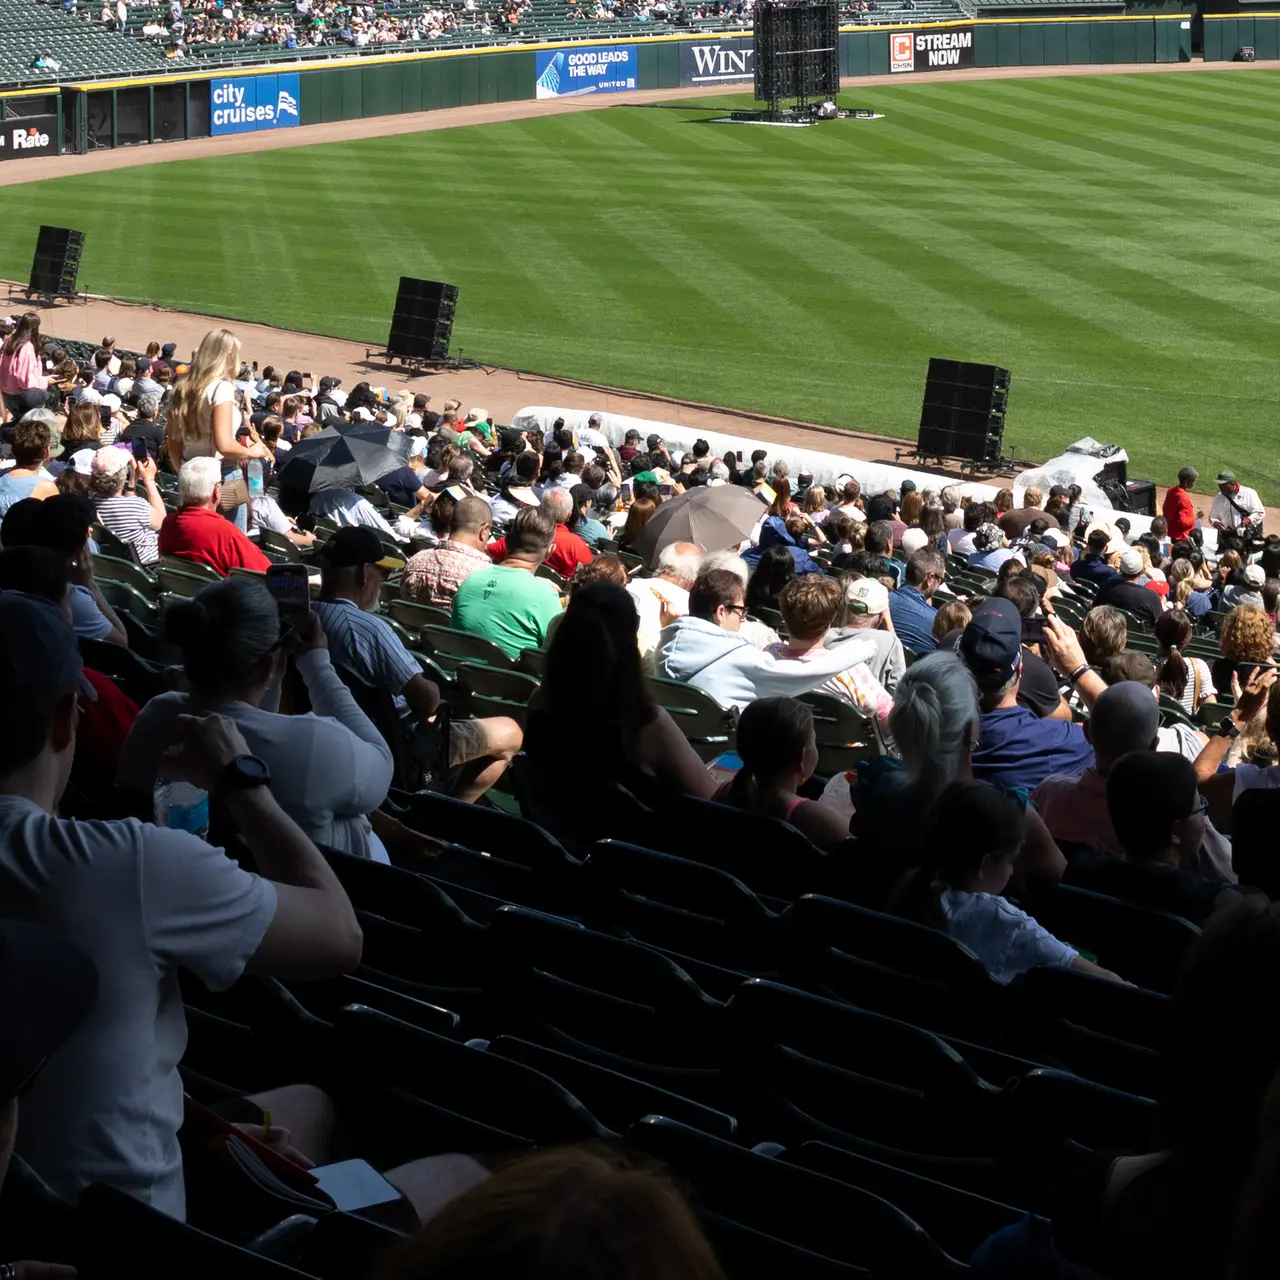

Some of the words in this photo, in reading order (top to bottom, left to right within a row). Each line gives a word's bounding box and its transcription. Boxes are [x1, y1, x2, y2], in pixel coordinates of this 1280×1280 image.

[915, 32, 972, 51] STREAM
[568, 52, 597, 65] GOOD
[598, 51, 629, 62] LEADS
[892, 62, 914, 70] CHSN
[928, 48, 961, 67] NOW
[568, 65, 586, 77] THE
[587, 64, 608, 75] WAY
[213, 84, 245, 107] city
[213, 104, 275, 126] cruises
[13, 128, 50, 149] Rate
